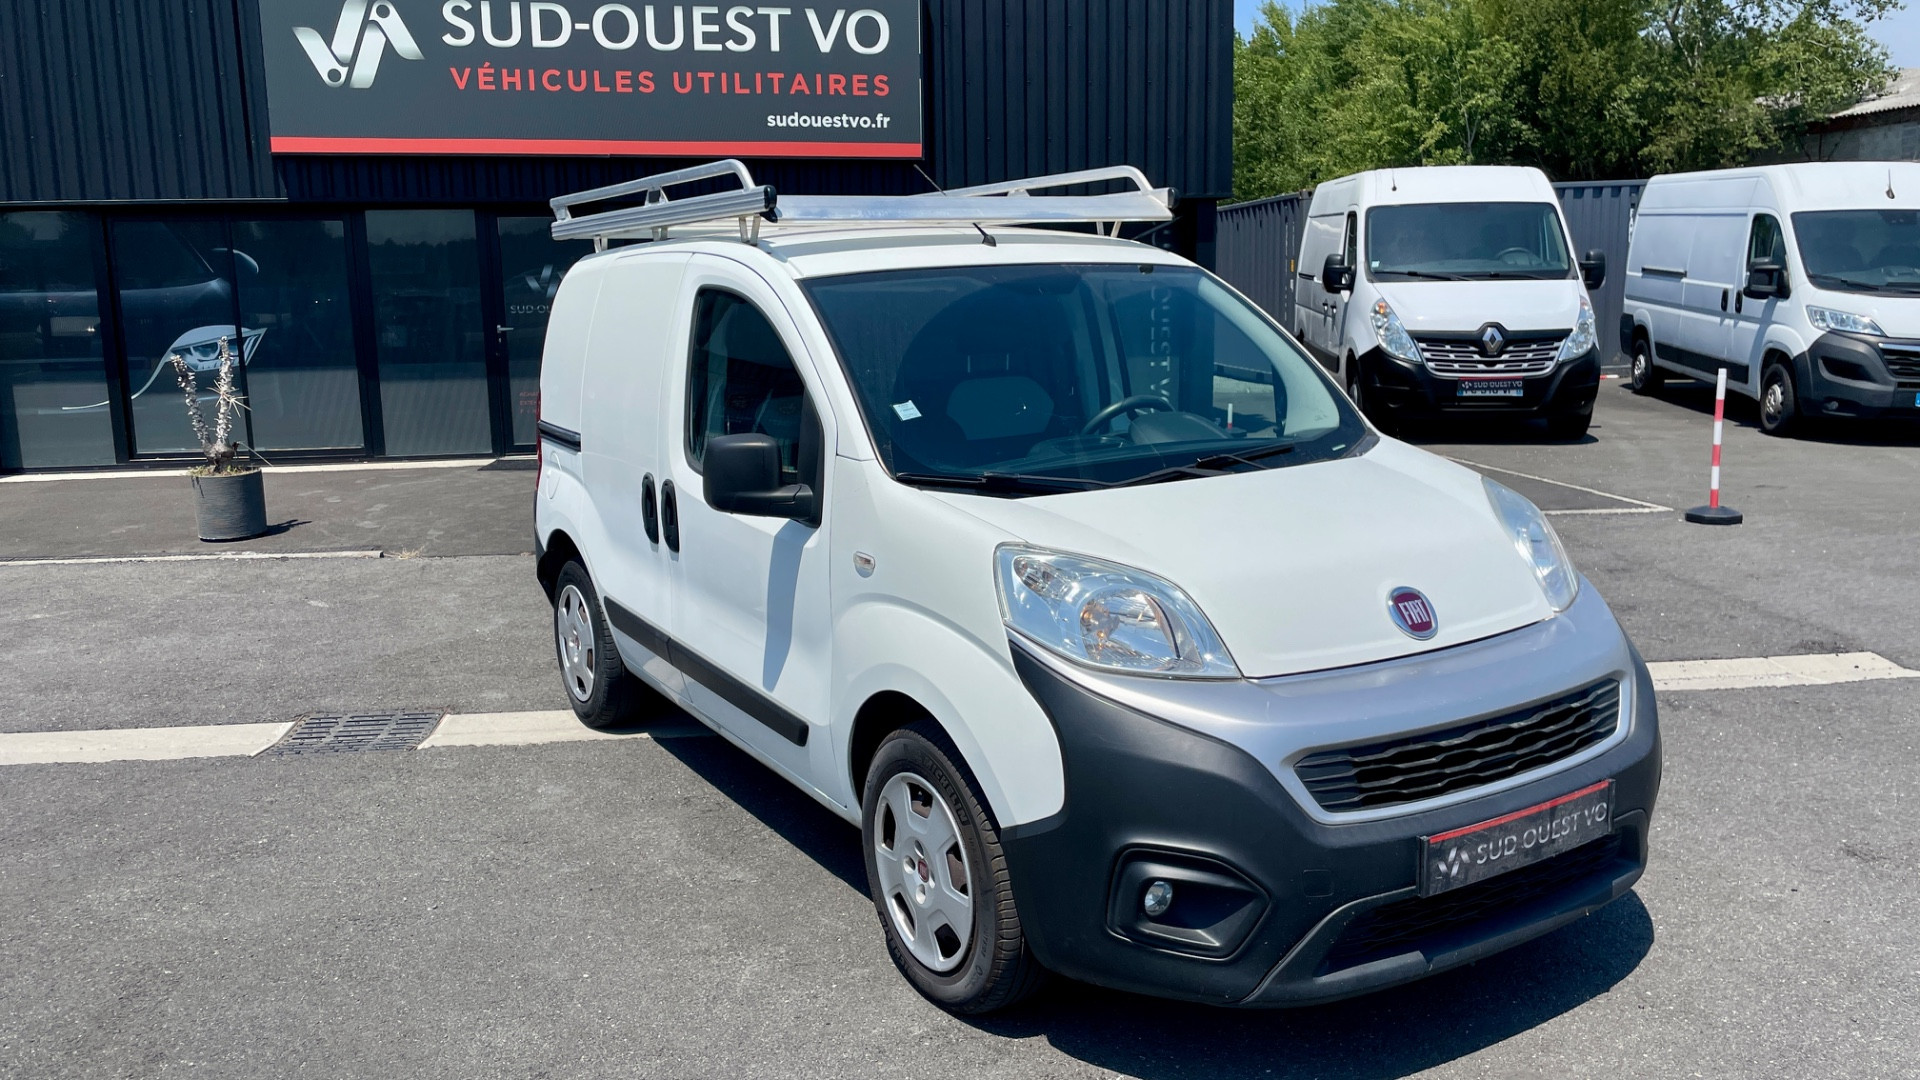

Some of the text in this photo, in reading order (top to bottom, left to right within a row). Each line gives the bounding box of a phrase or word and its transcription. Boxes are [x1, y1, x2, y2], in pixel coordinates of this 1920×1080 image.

[441, 0, 890, 54] SUD-OUEST VO
[450, 62, 889, 97] VÉHICULES UTILITAIRES
[766, 111, 890, 130] sudouestvo.fr
[1398, 599, 1430, 625] FIAT
[922, 757, 971, 826] MICHELIN
[1476, 802, 1607, 865] SUD OUEST VO
